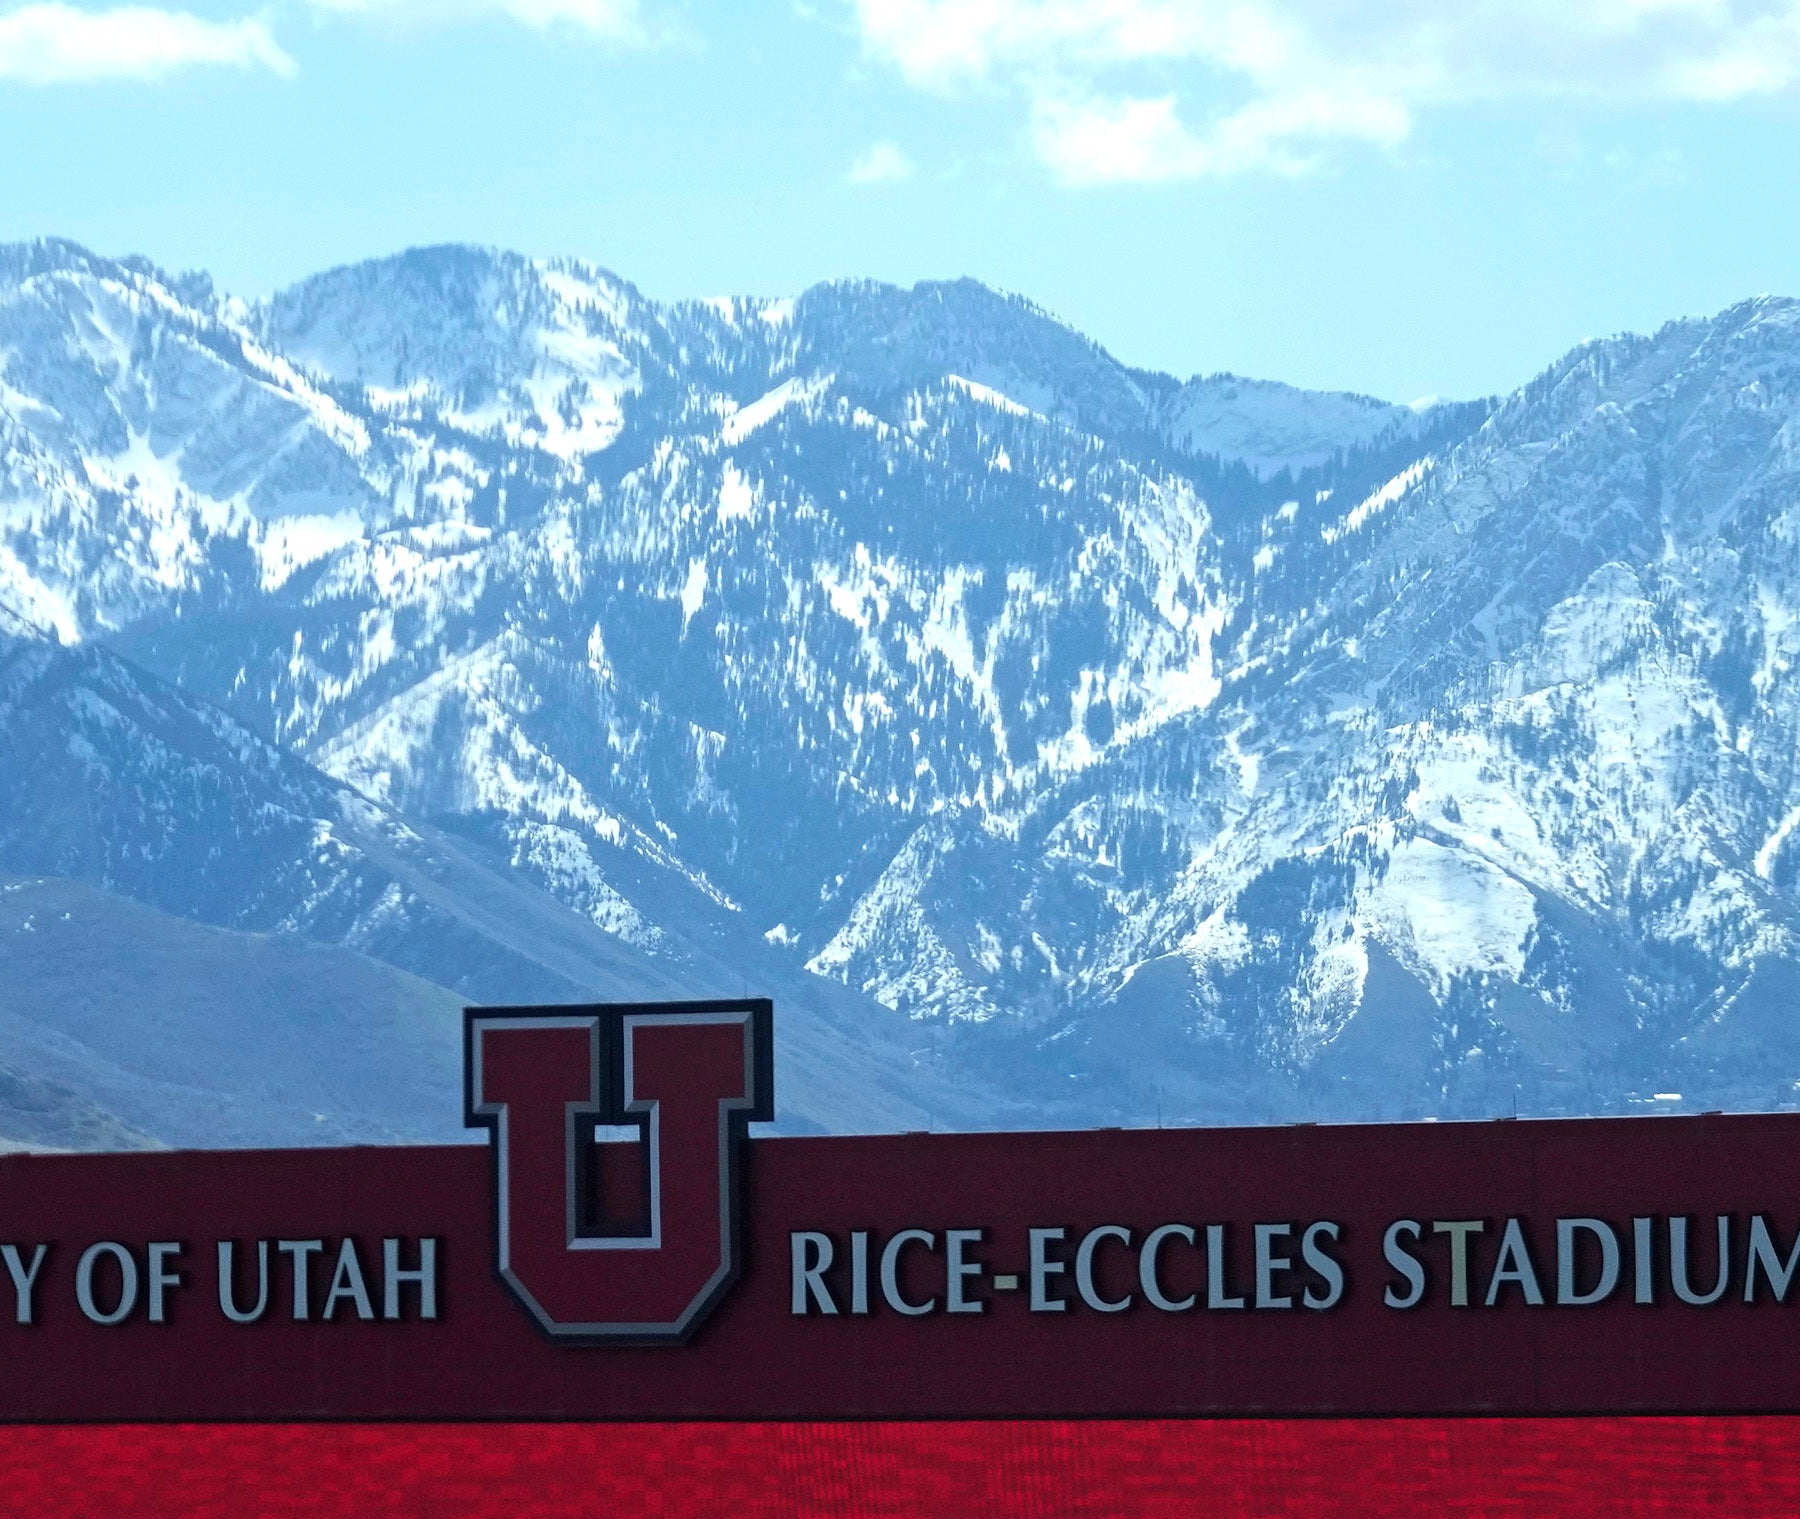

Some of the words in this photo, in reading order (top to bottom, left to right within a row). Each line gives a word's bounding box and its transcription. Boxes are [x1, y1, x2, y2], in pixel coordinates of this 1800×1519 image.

[463, 998, 774, 1347] U
[75, 1240, 181, 1324] OF
[216, 1236, 437, 1322] UTAH
[790, 1221, 1344, 1317] RICE-ECCLES
